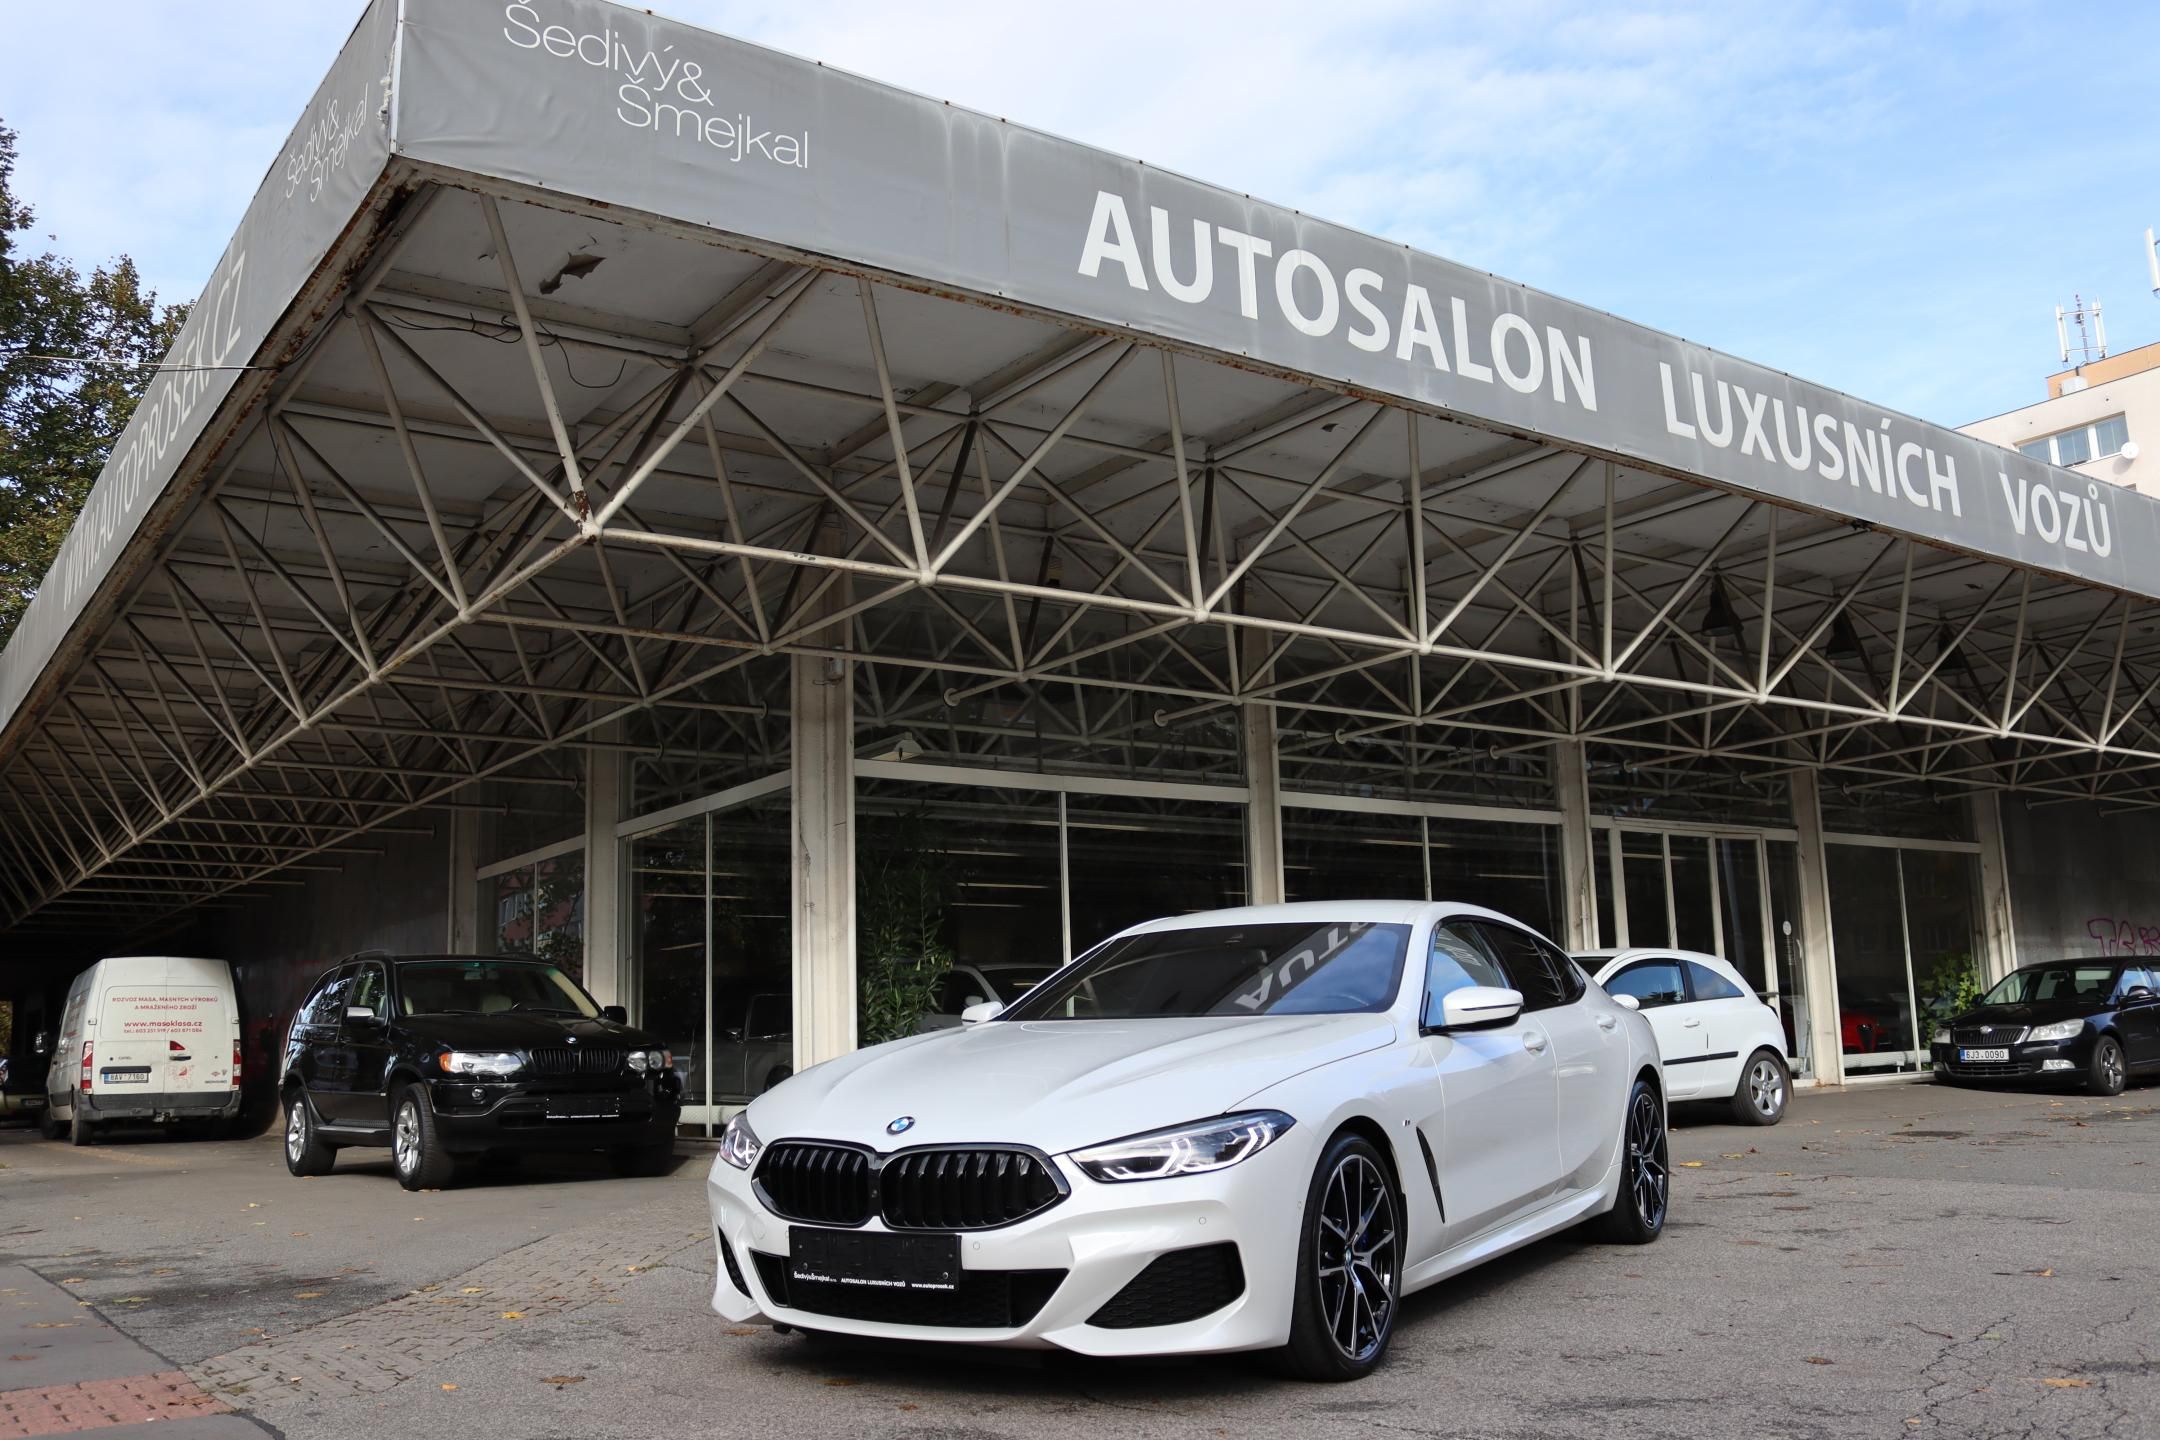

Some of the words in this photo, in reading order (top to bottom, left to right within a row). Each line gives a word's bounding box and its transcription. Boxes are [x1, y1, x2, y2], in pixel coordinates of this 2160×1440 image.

[616, 72, 808, 169] Šmejkal
[1077, 190, 1598, 412] AUTOSALON
[1658, 361, 1962, 518] LUXUSNÍCH
[1999, 471, 2113, 558] VOZŮ
